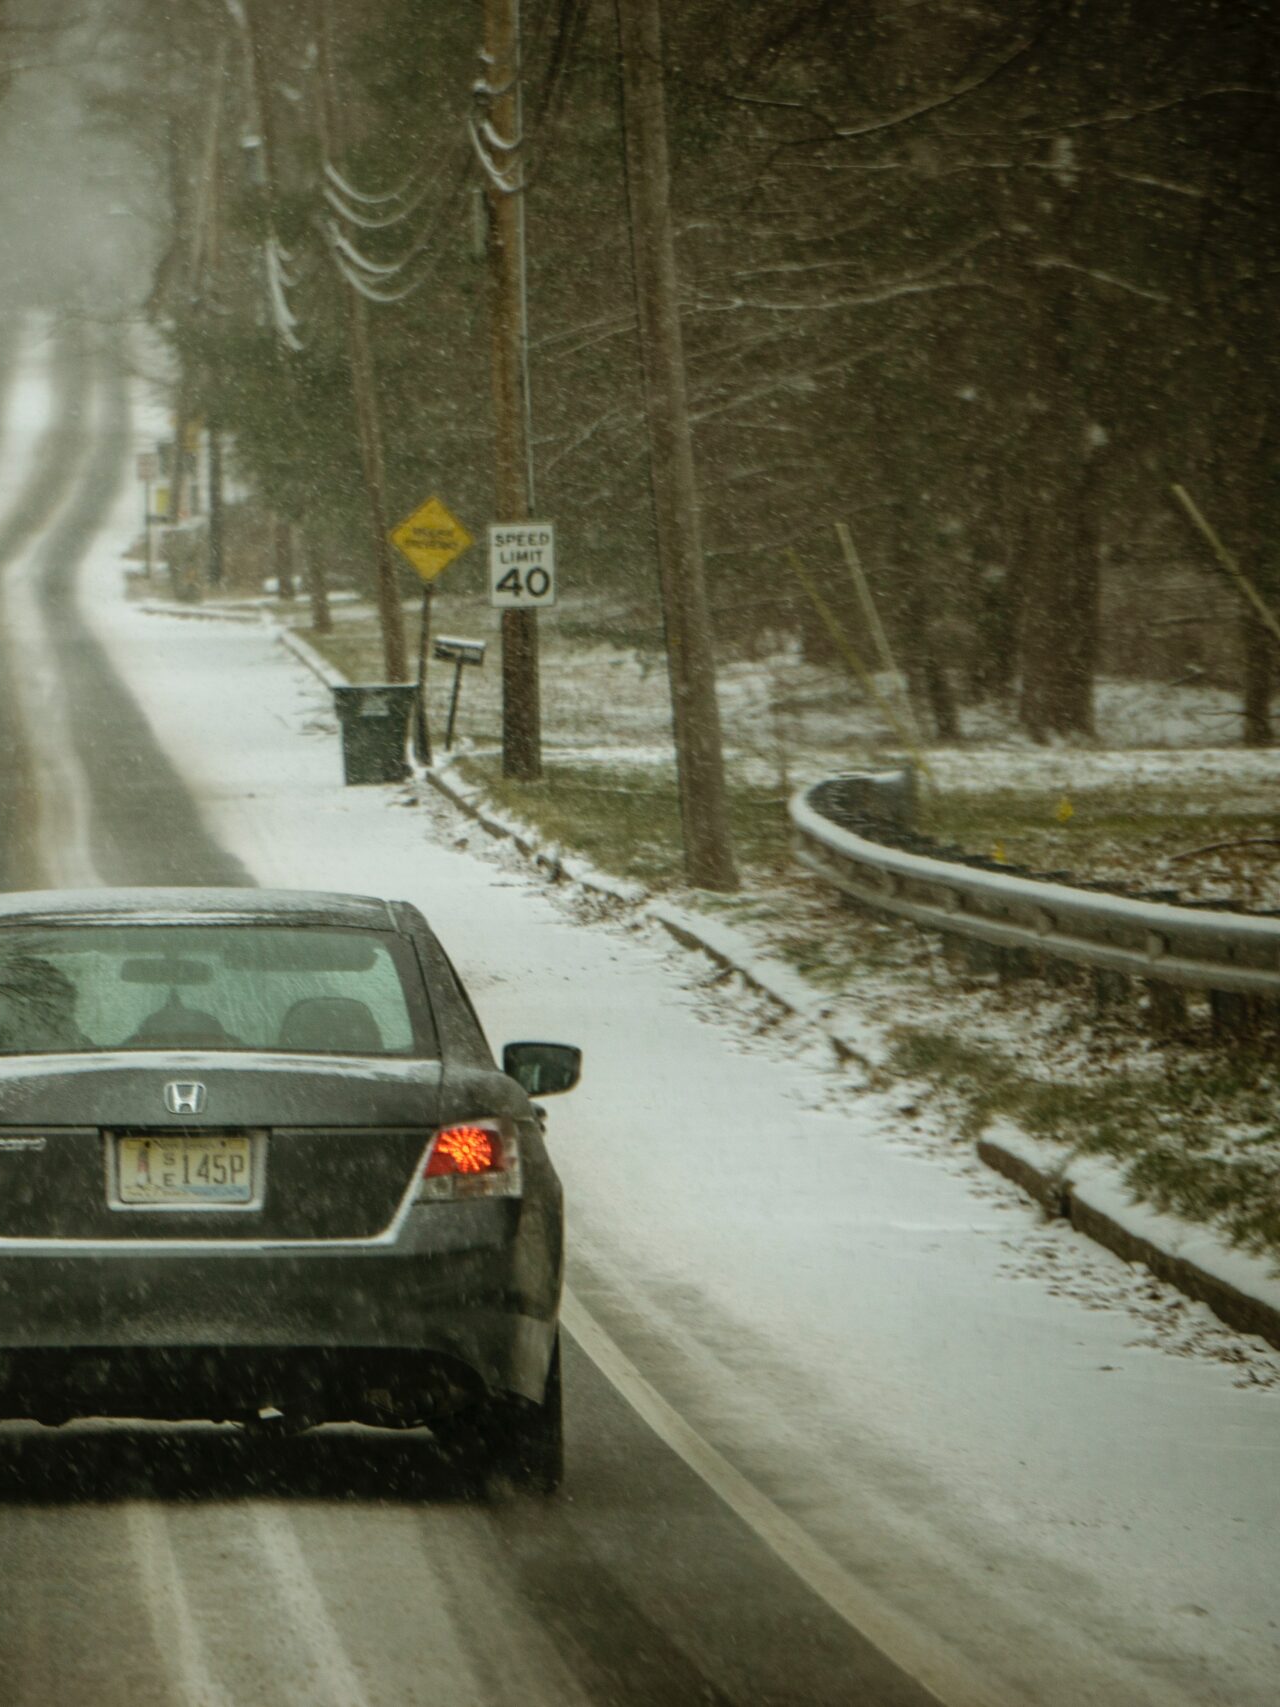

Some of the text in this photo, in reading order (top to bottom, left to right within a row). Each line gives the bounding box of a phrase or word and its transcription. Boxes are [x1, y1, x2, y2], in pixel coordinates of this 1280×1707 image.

[494, 532, 550, 547] SPEED
[500, 550, 544, 564] LIMIT
[496, 567, 550, 598] 40
[181, 1154, 244, 1185] 145P
